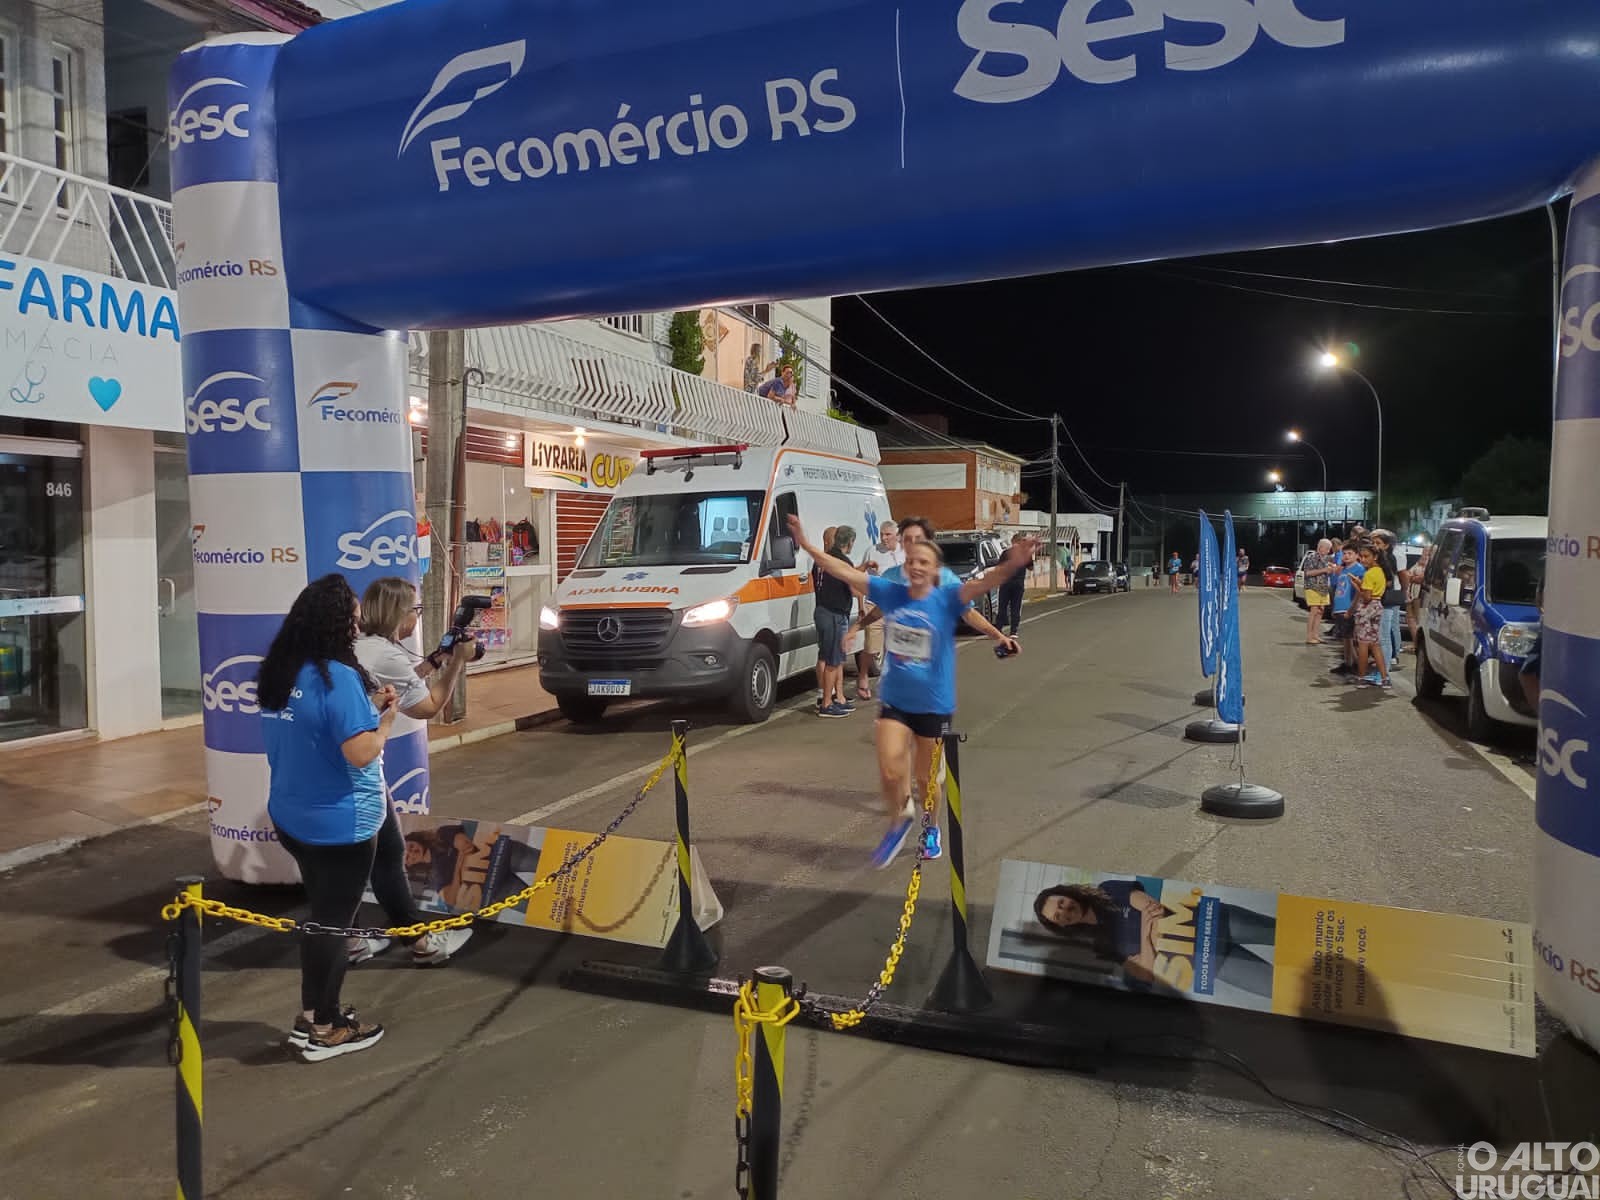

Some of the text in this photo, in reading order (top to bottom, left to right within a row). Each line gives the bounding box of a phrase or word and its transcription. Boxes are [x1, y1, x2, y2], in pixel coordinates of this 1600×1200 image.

[429, 68, 857, 192] Fecomércio RS
[177, 259, 278, 285] ecomércio RS
[45, 482, 73, 497] 846
[193, 547, 299, 564] ecomércio RS
[202, 672, 260, 715] Ses
[210, 823, 281, 842] ecomércio
[1315, 910, 1325, 947] mundo
[1327, 909, 1336, 922] os
[1200, 964, 1209, 991] TODOS
